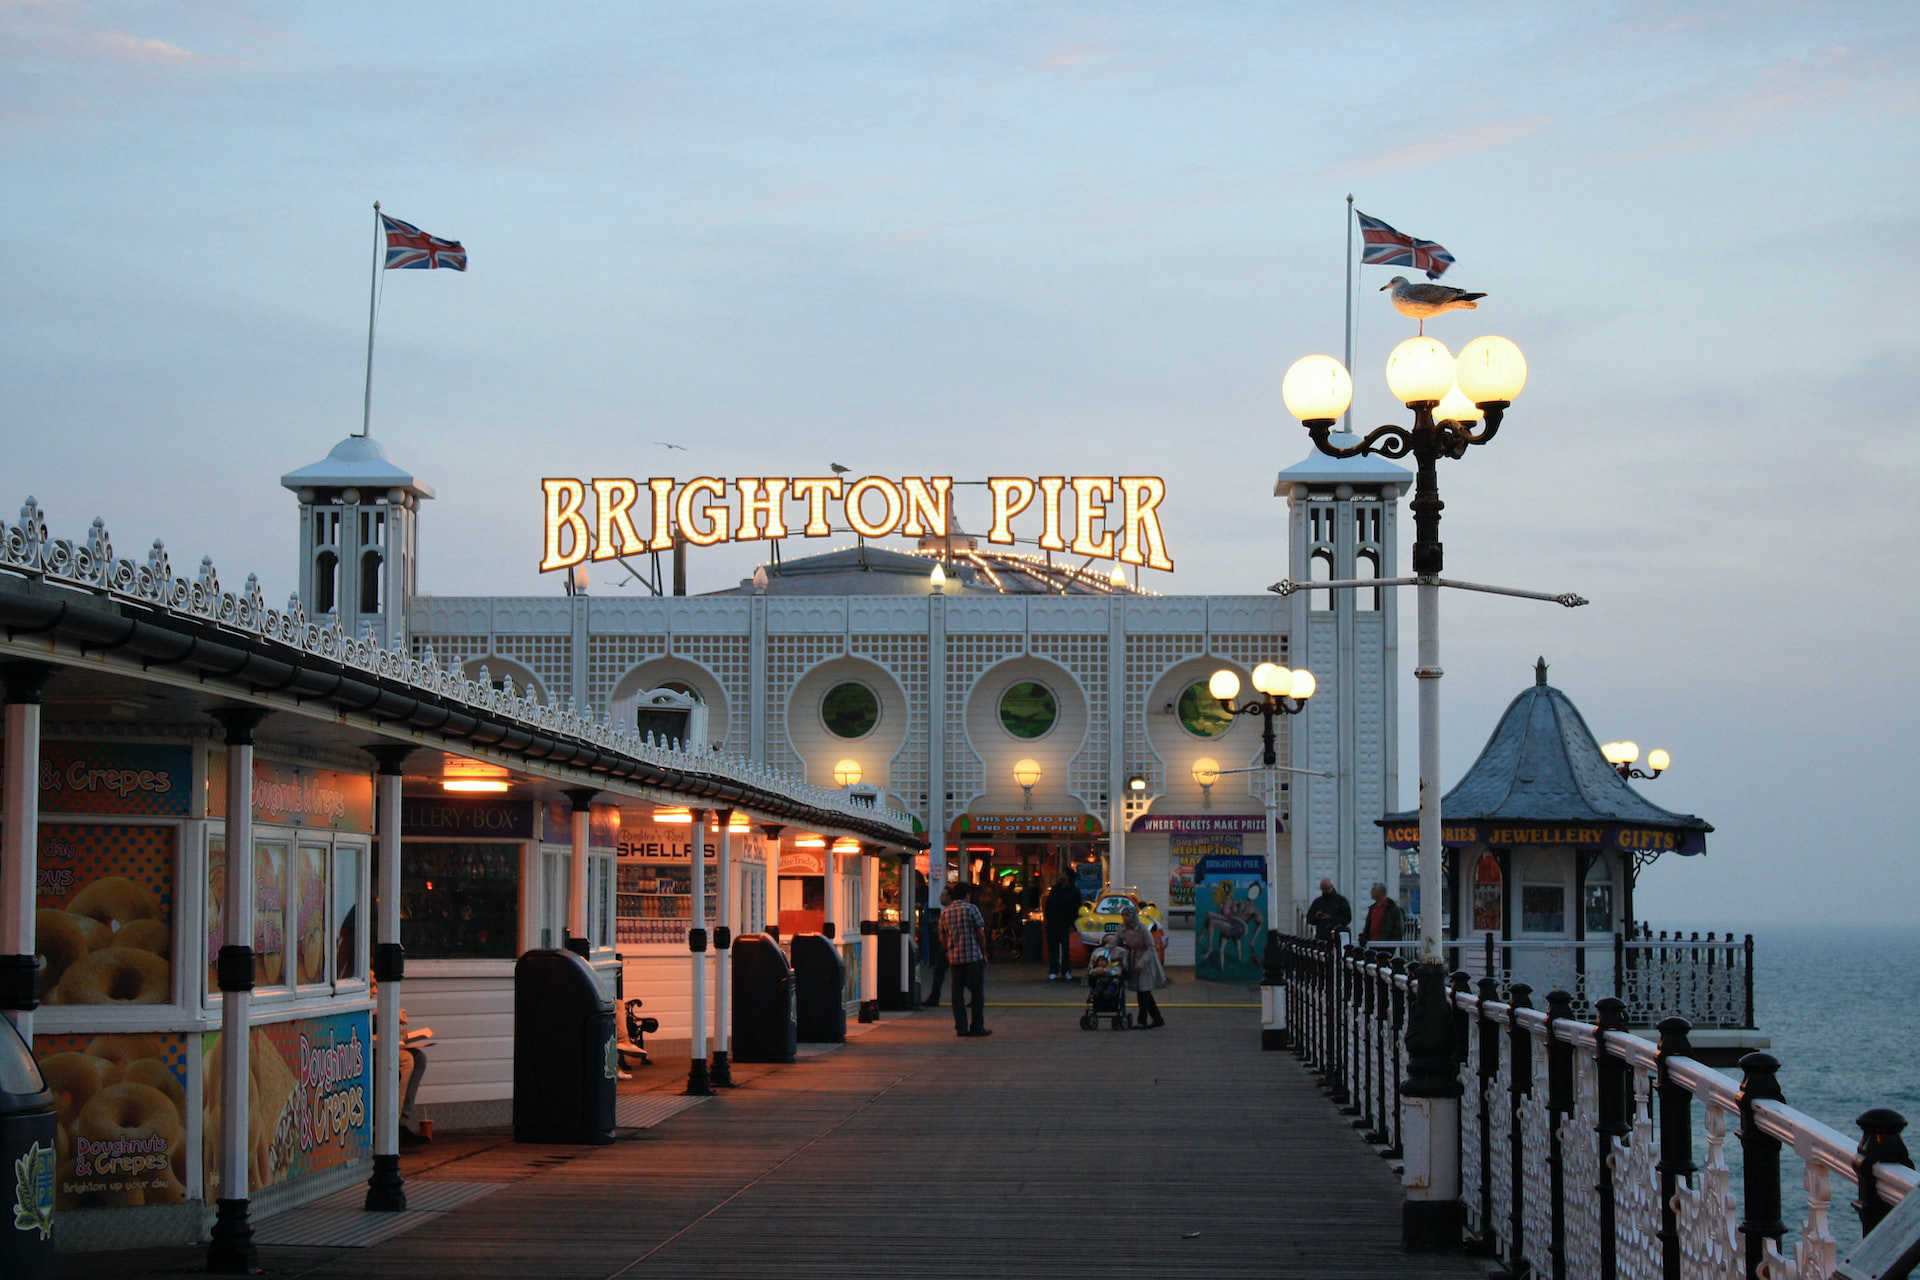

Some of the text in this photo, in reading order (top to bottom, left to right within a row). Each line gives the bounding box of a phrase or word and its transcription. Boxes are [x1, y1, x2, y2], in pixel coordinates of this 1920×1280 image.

[539, 475, 1175, 574] BRIGHTON PIER
[65, 759, 173, 799] Crepes
[472, 807, 513, 829] BOX
[1144, 819, 1267, 831] WHERE TICKETS MAKE PRIZE
[1489, 827, 1604, 845] JEWELLERY
[1618, 829, 1676, 849] GIFTS
[1173, 846, 1240, 856] REDEMPTION
[300, 1024, 364, 1093] Doughnuts
[300, 1084, 366, 1153] & Crepes
[77, 1132, 169, 1158] Doughnuts
[75, 1152, 169, 1177] & Crepes
